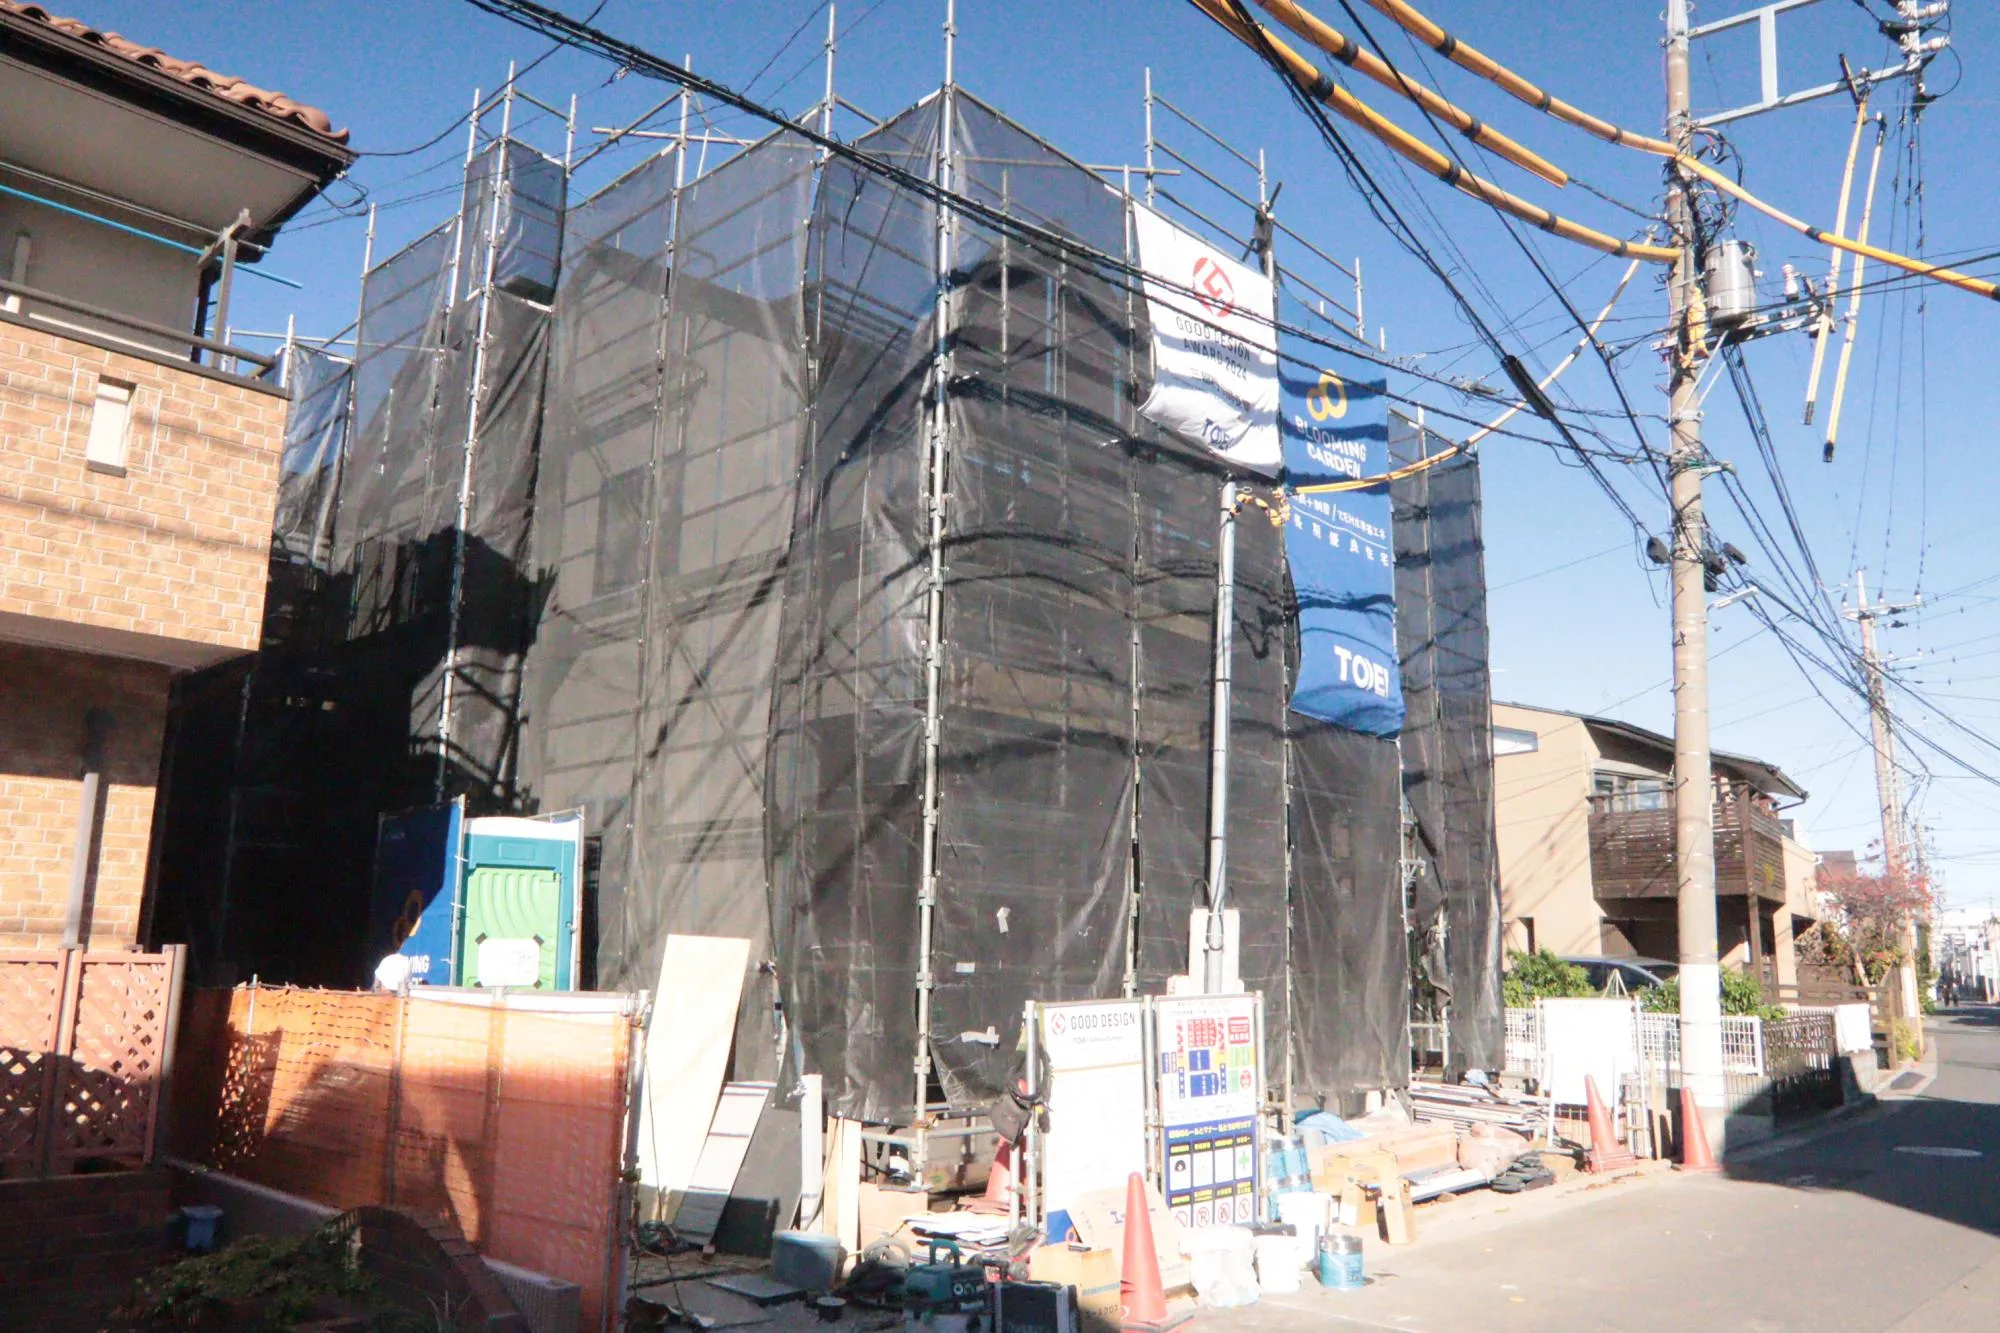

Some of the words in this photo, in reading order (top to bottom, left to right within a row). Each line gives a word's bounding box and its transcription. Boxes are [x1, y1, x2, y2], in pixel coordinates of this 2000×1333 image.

[1175, 316, 1211, 339] GOOD
[1213, 329, 1251, 361] DESIGN
[1183, 338, 1222, 365] AWARD
[1225, 356, 1248, 381] 2024
[1295, 416, 1367, 463] BLOOMING
[1307, 441, 1361, 480] GARDEN
[1070, 1014, 1098, 1030] GOOD
[1100, 1012, 1136, 1027] DESIGN
